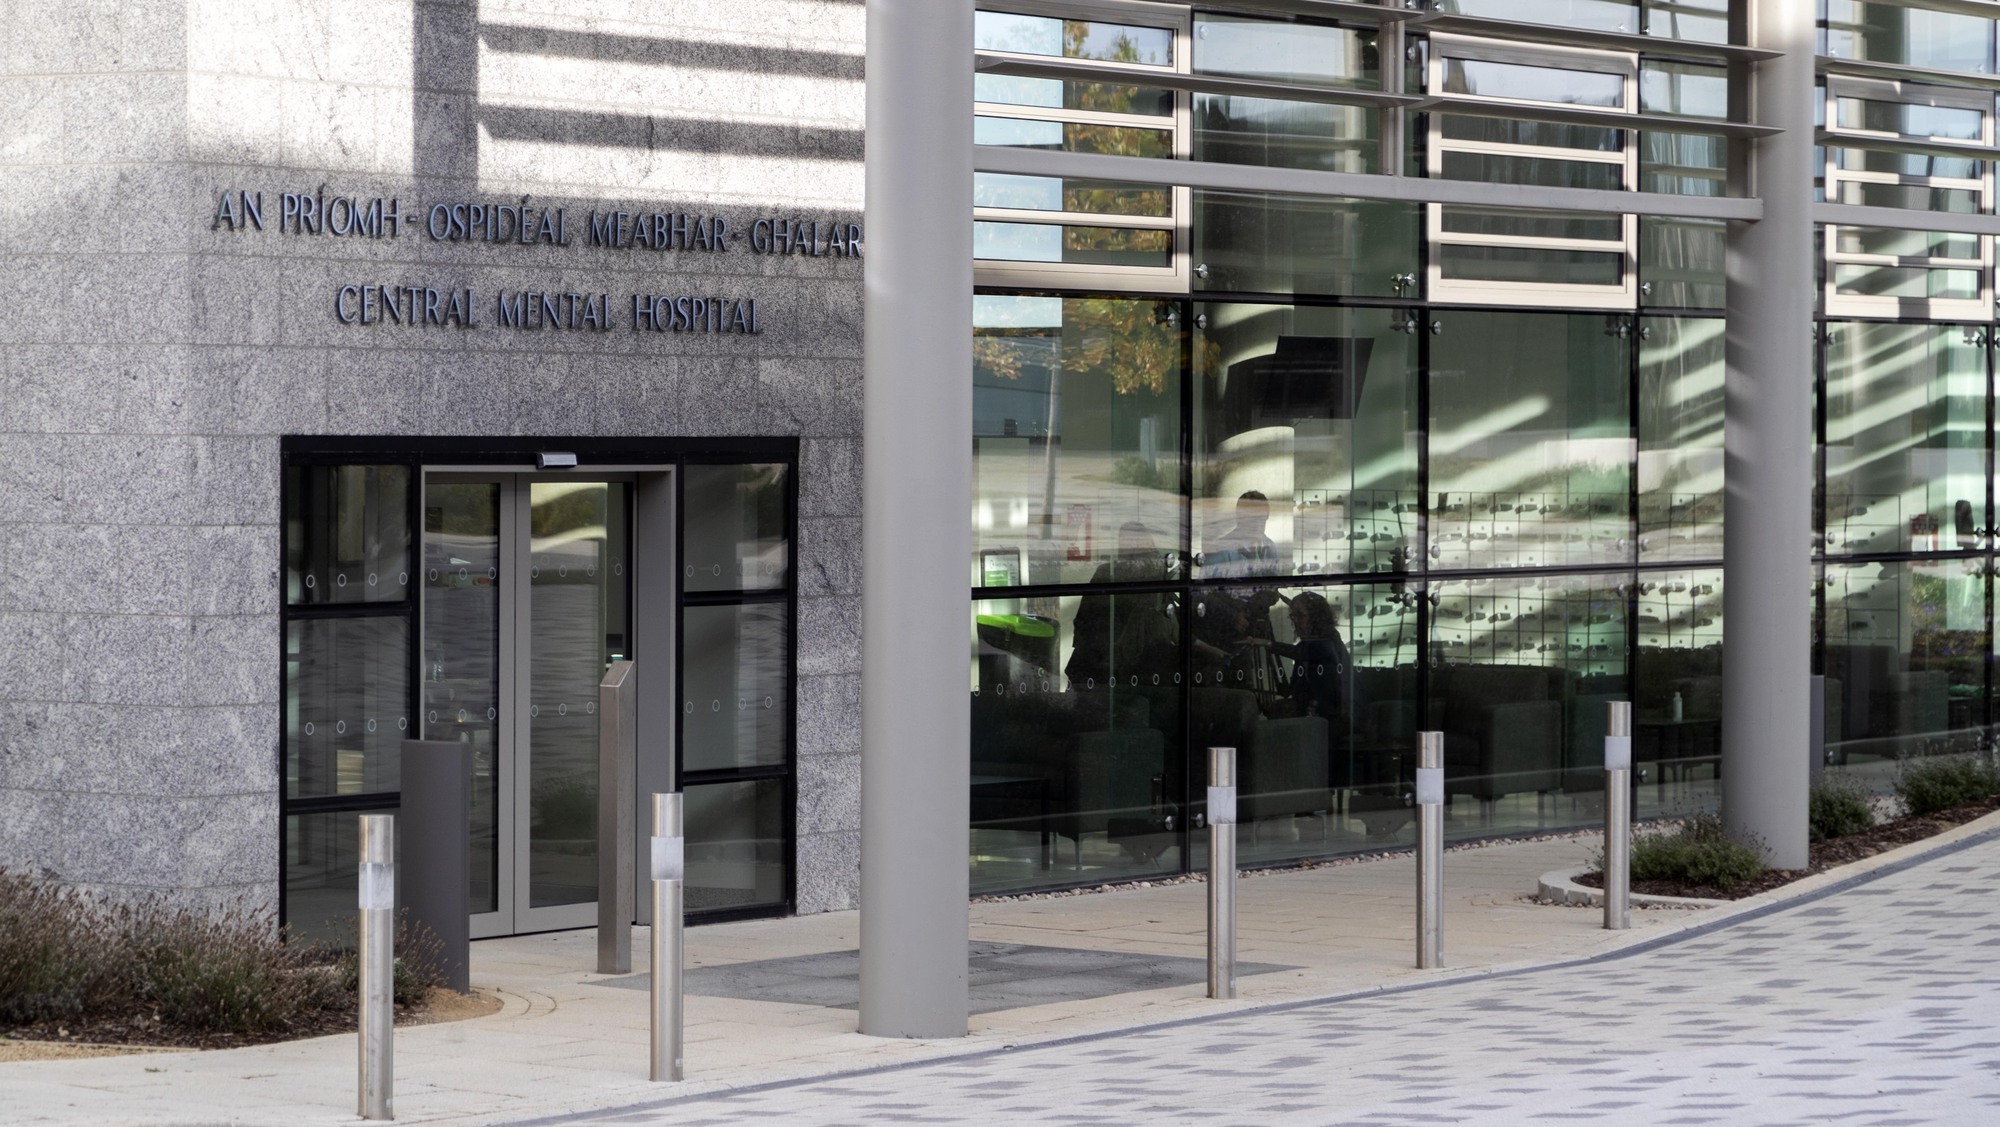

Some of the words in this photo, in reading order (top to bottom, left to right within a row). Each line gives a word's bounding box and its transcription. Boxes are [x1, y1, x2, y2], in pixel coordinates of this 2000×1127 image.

[214, 190, 263, 231] AN
[338, 285, 476, 326] CENTRAL
[499, 290, 611, 330] MENTAL
[634, 294, 761, 334] HOSPITAL
